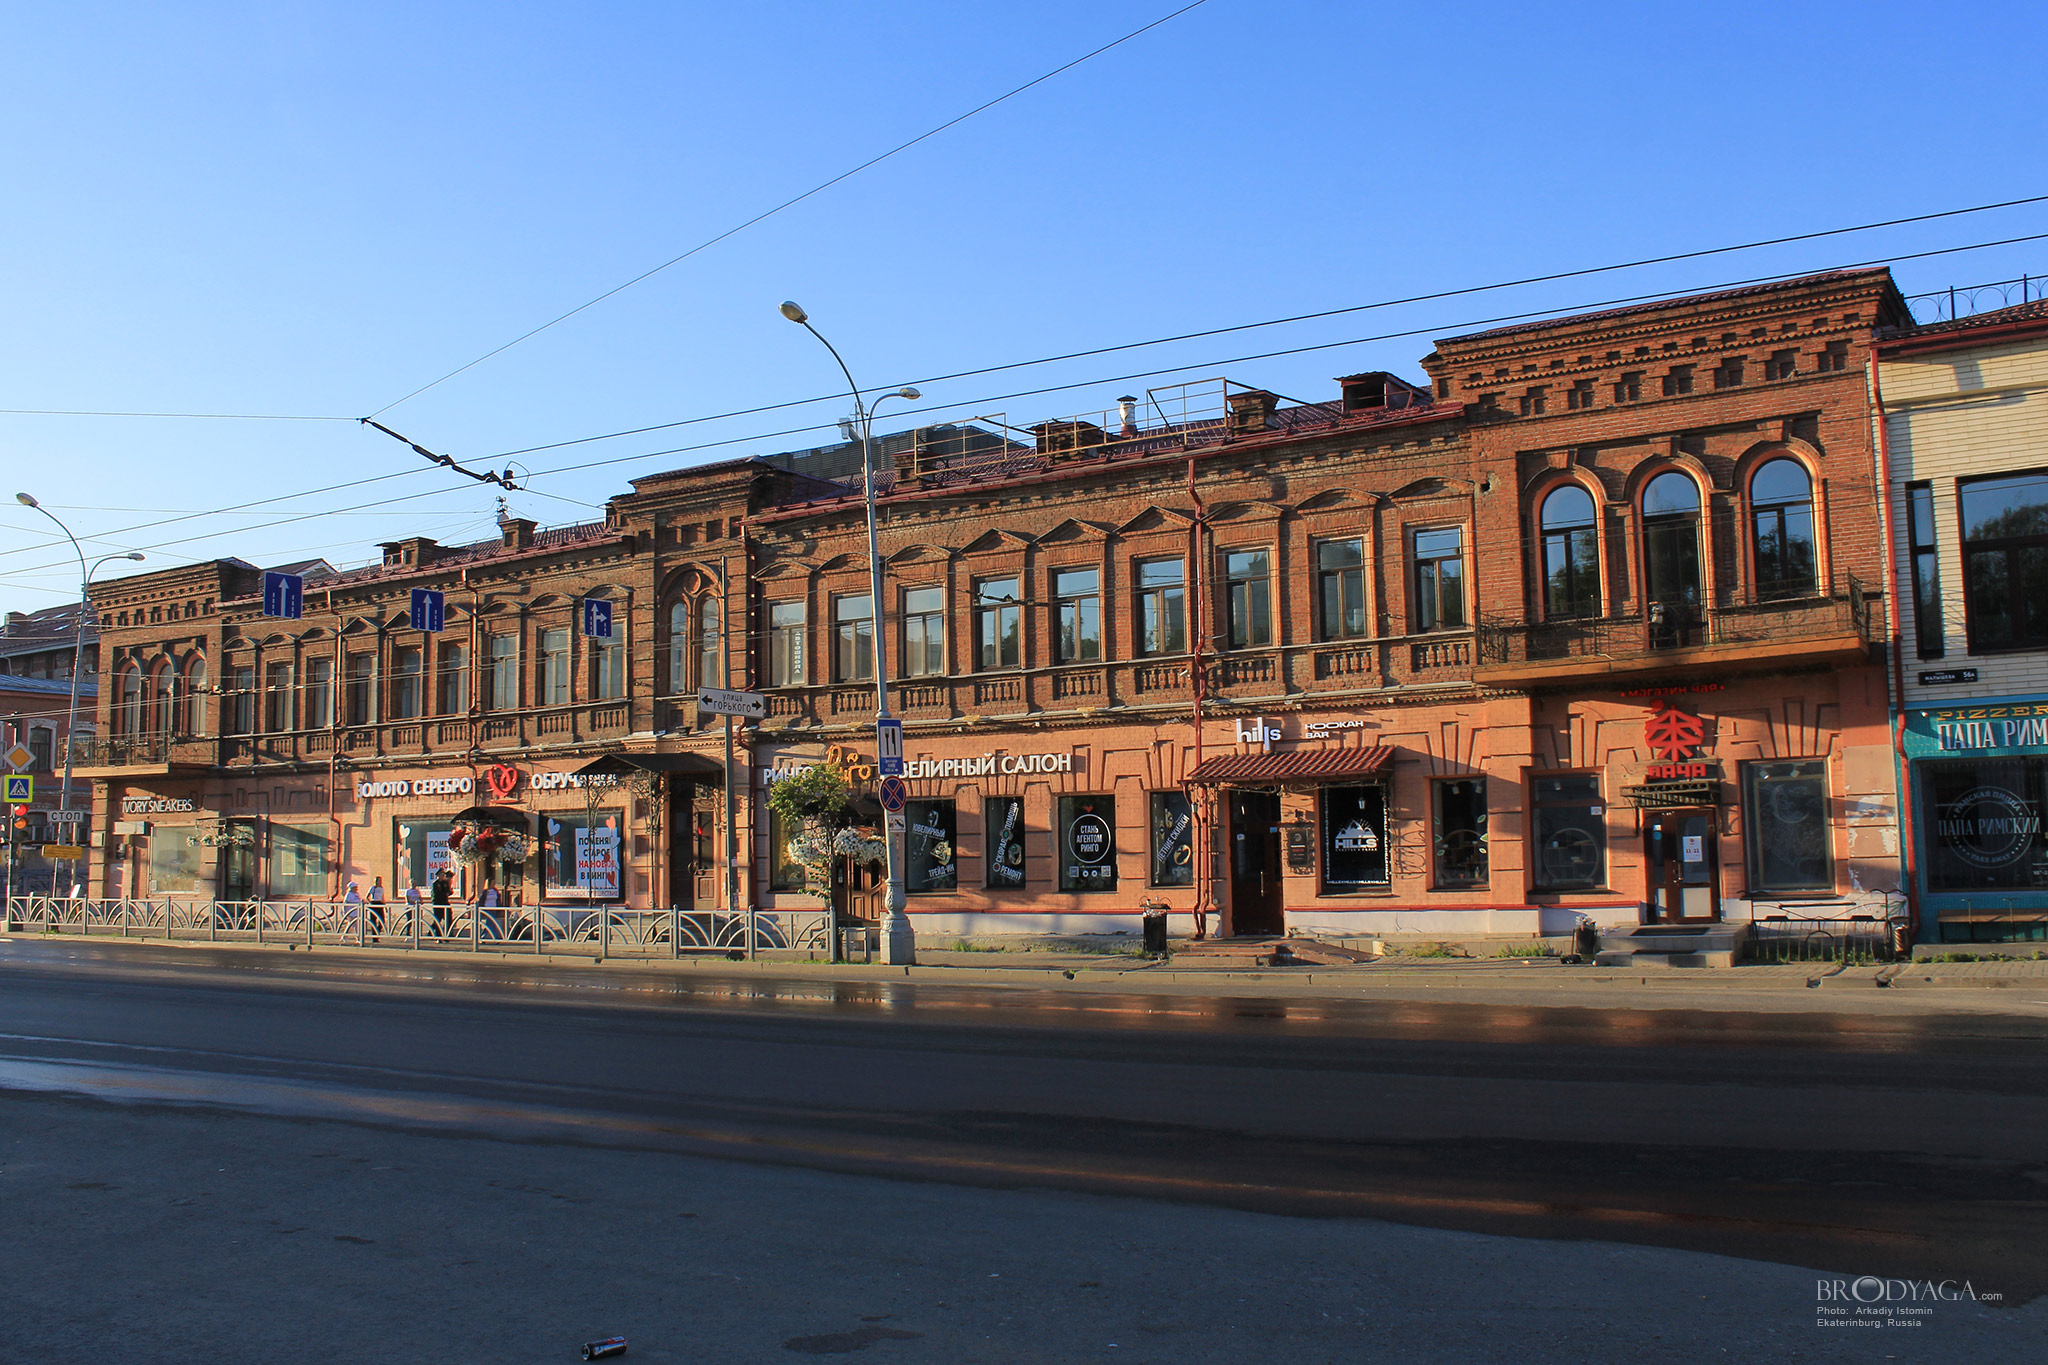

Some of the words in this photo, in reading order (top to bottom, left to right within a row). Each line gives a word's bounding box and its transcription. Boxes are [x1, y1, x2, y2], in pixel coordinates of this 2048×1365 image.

[1628, 687, 1687, 697] магазин
[1691, 684, 1718, 693] чая
[722, 693, 743, 702] улица
[713, 700, 752, 713] ГОРЬКОГО
[1304, 720, 1364, 730] HOOKAH
[1236, 716, 1281, 751] hills
[1305, 731, 1330, 739] BAR
[1937, 722, 1997, 751] ПАПА
[902, 753, 996, 779] ВЕЛИРНЫЙ
[1001, 753, 1072, 774] САЛОН
[356, 780, 410, 798] ЗОЛОТО
[412, 777, 473, 795] СЕРЕБРО
[148, 798, 193, 812] SNEAKERS
[51, 812, 81, 821] СТОП
[1004, 802, 1018, 830] ПОМОЩЬ
[1080, 825, 1099, 834] СТАНЬ
[1169, 814, 1190, 841] СКИДКИ
[1938, 818, 1974, 836] ПАПА
[1978, 810, 2041, 835] РИМСКИЙ
[1076, 834, 1102, 843] АГЕНТОМ
[1335, 838, 1378, 849] HILLS
[1080, 843, 1099, 853] РИНГО
[578, 860, 589, 868] НА
[1000, 865, 1022, 880] РЕМОНТ
